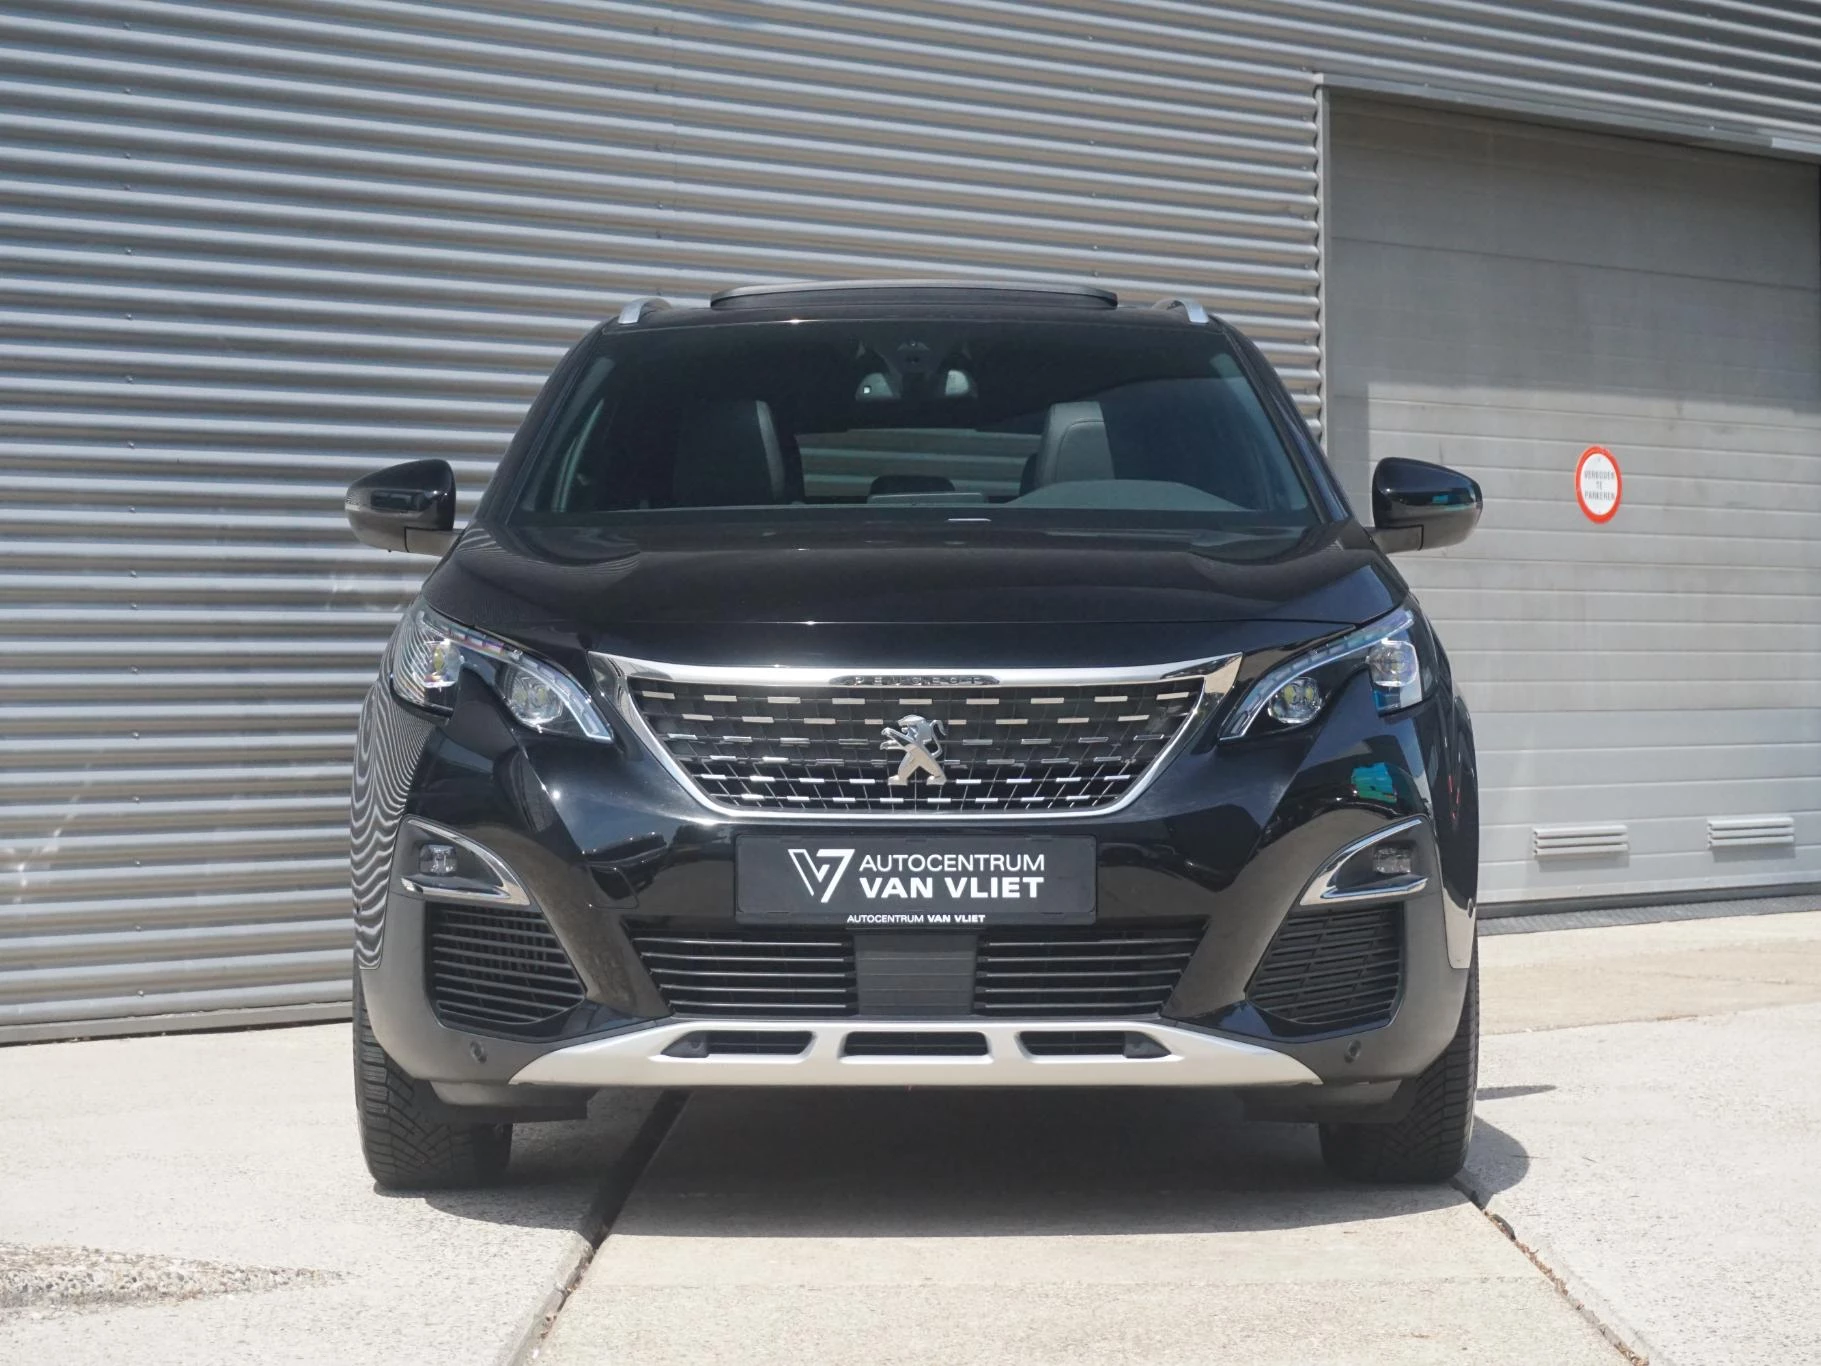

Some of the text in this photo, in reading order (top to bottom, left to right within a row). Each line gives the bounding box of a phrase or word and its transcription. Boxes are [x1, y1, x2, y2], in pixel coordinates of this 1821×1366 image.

[858, 854, 1045, 872] AUTOCENTRUM
[858, 877, 1045, 899] VAN VLIET
[846, 914, 986, 924] AUTOCENTRUM VAN VLIET
